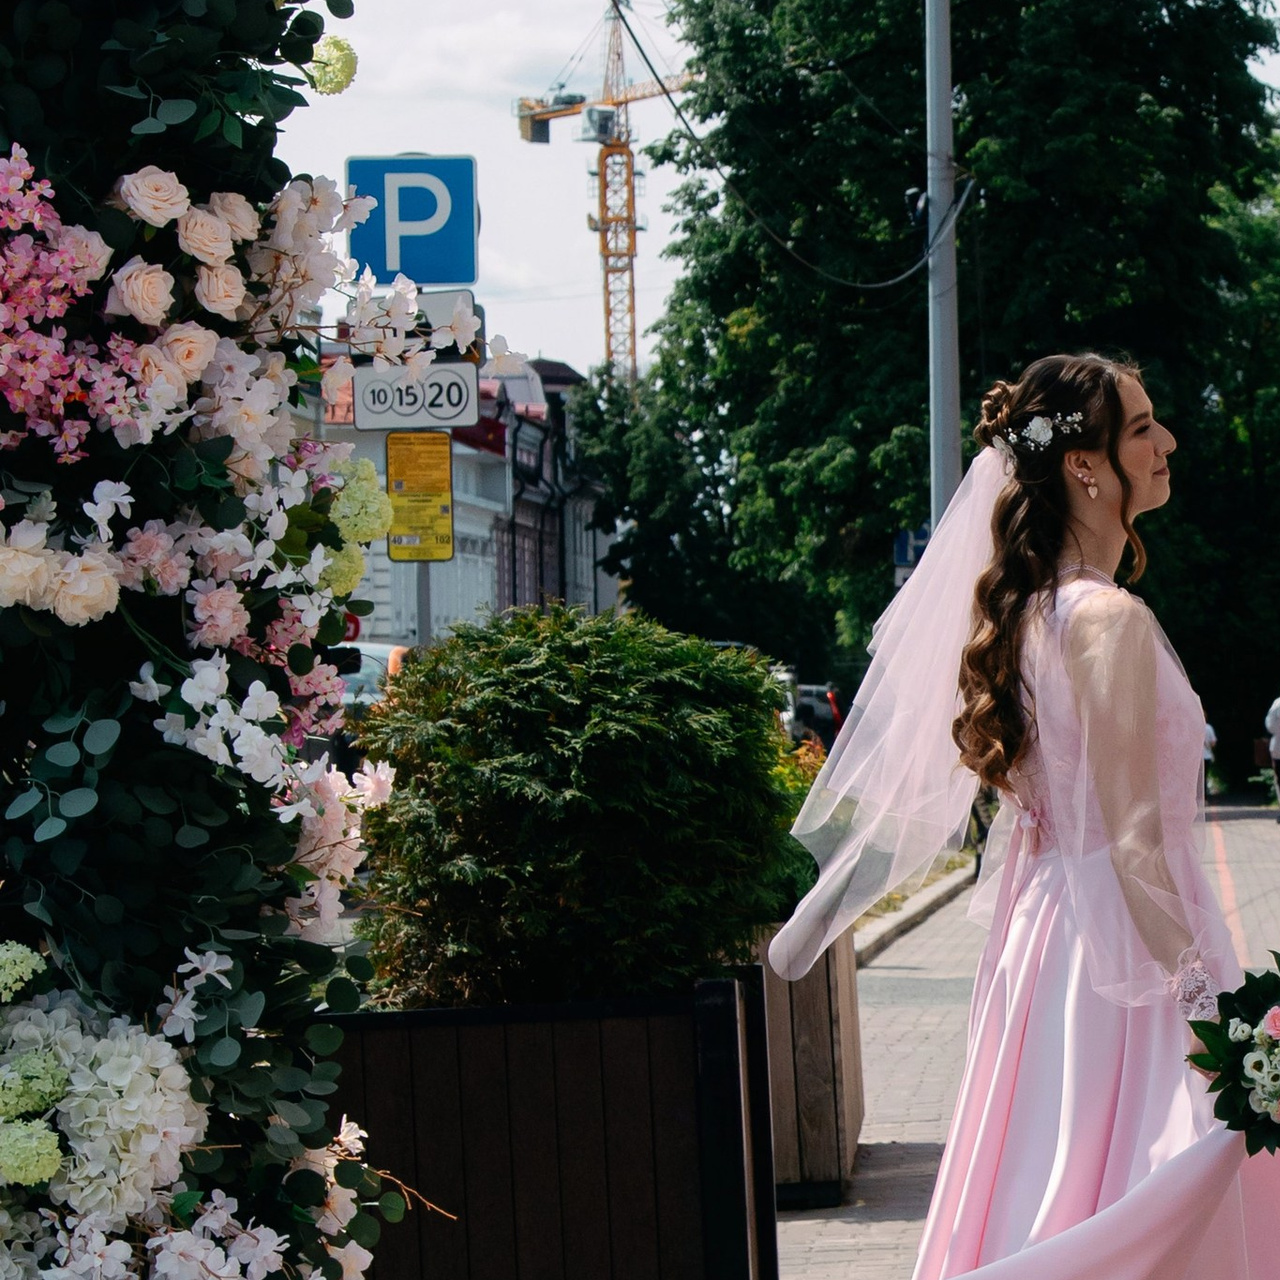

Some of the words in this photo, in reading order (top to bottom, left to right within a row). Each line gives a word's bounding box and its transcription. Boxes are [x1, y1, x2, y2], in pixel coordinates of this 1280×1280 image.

[384, 172, 452, 271] P
[369, 388, 388, 405] 10
[396, 385, 418, 407] 15
[428, 381, 463, 408] 20
